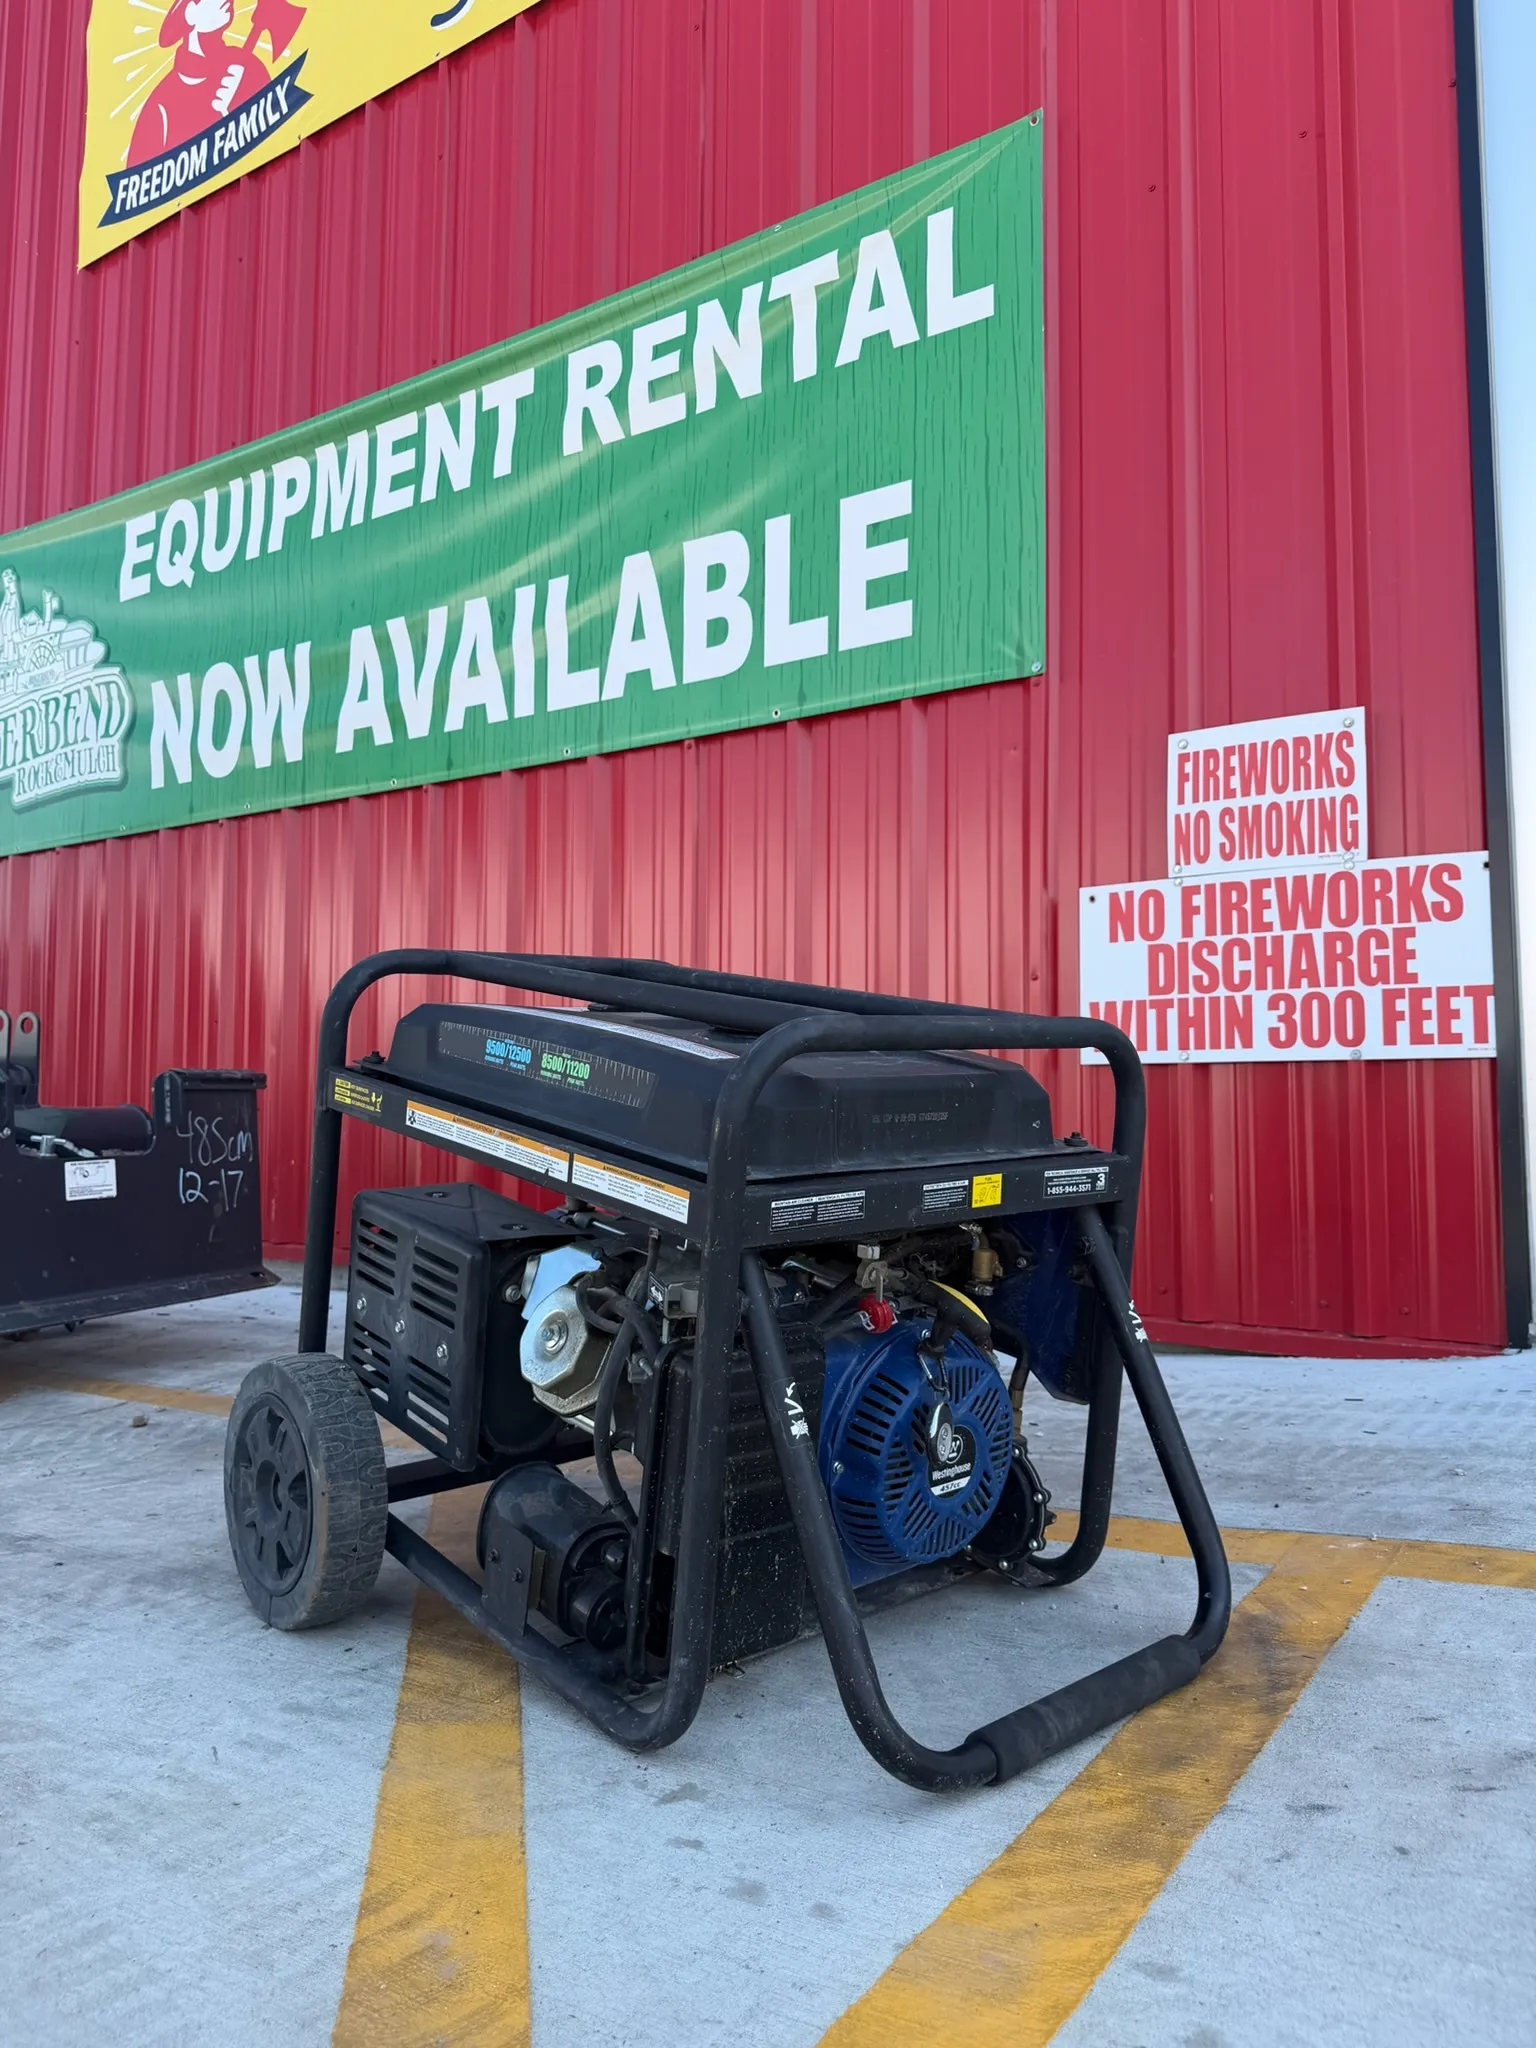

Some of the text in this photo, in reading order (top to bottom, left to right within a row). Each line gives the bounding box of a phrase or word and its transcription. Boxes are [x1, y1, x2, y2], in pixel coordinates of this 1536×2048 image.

[115, 76, 290, 214] FREEDOM FAMILY
[119, 206, 994, 602] EQUIPMENT RENTAL
[150, 479, 913, 789] NOW AVAILABLE
[1176, 730, 1355, 805] FIREWORKS
[1174, 793, 1359, 866] NO SMOKING
[1108, 863, 1464, 943] NO FIREWORKS
[1147, 927, 1419, 996] DISCHARGE
[1267, 990, 1366, 1049] 300
[1382, 984, 1494, 1046] FEET
[485, 1039, 532, 1064] 9500/12500
[541, 1053, 591, 1080] 8500/11200
[179, 1167, 244, 1211] 12-17
[1047, 1184, 1092, 1195] 1-855-944-3571
[1097, 1173, 1106, 1184] 3
[932, 1462, 972, 1481] Westinghouse
